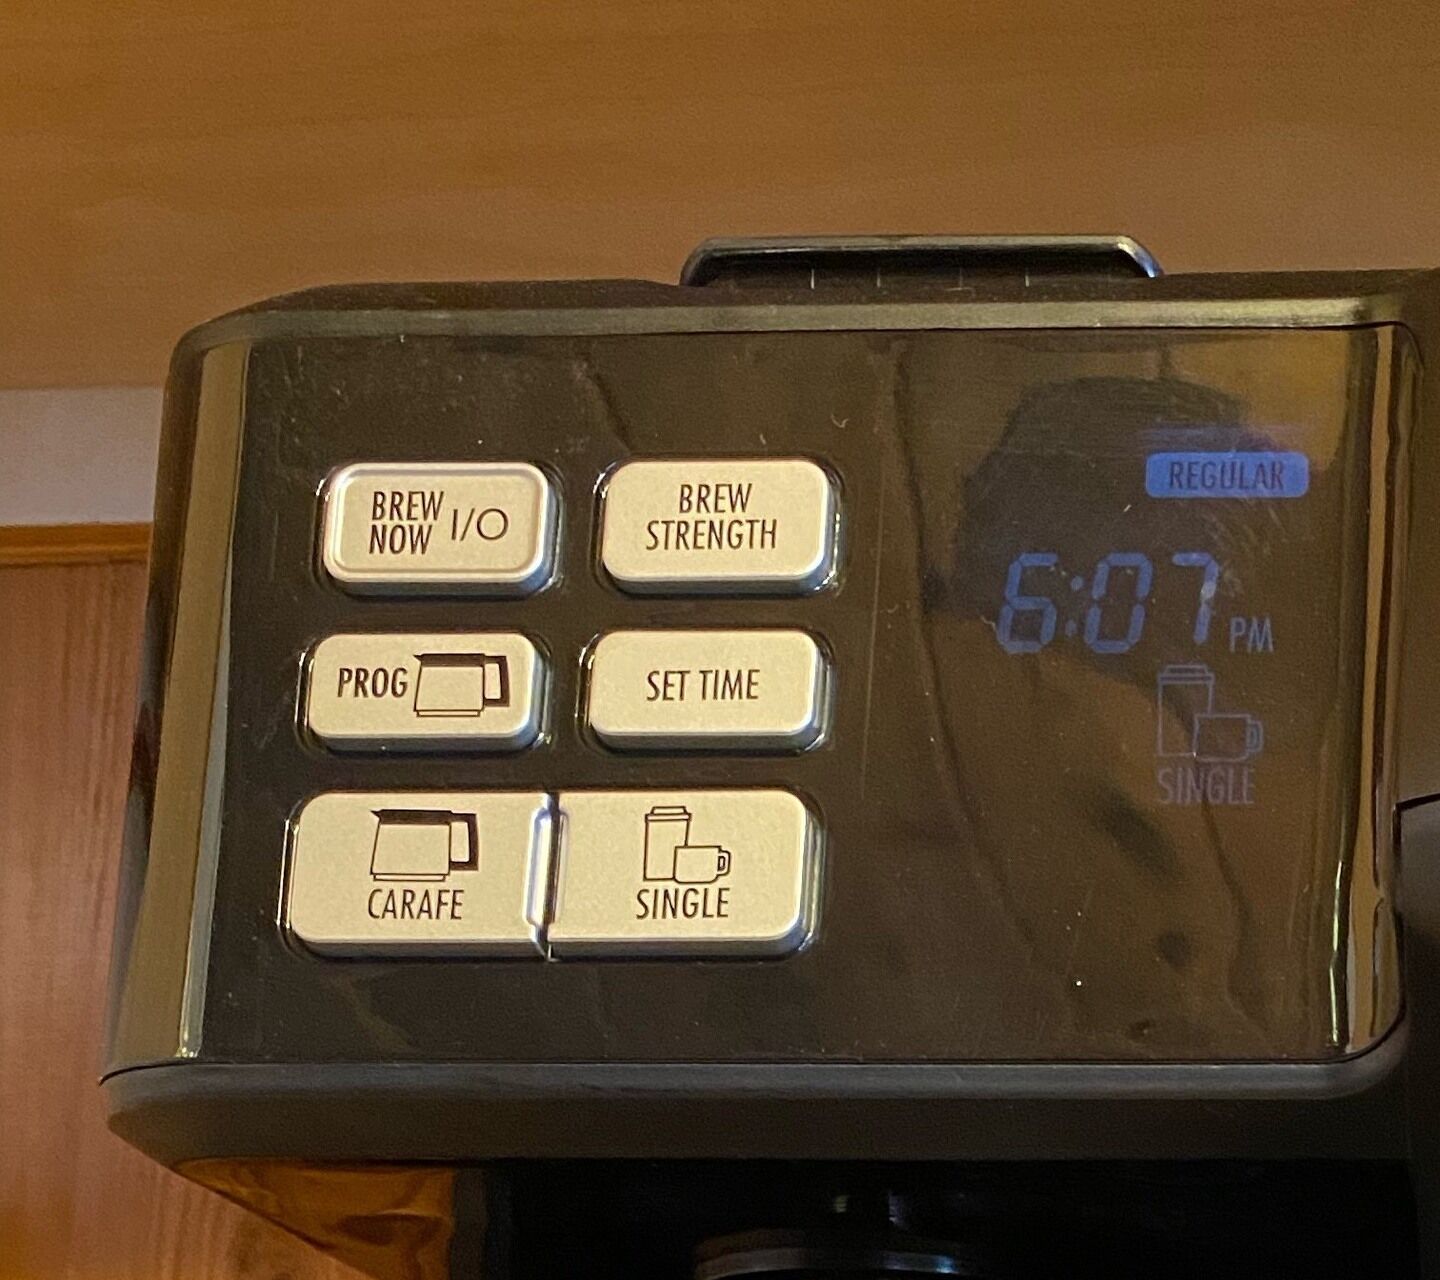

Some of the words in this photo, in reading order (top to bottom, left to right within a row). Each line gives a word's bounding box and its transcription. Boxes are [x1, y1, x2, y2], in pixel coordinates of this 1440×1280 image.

[1168, 459, 1286, 492] REGULAR
[371, 490, 445, 522] BREW
[678, 482, 753, 515] BREW
[368, 523, 434, 556] NOW
[645, 518, 778, 551] STRENGTH
[996, 551, 1221, 655] 6:07
[1229, 616, 1275, 653] PM
[336, 666, 409, 699] PROG
[645, 668, 690, 702] SET
[697, 667, 761, 701] TIME
[1156, 765, 1255, 805] SINGLE
[367, 887, 466, 921] CARAFE
[635, 886, 731, 920] SINGLE
